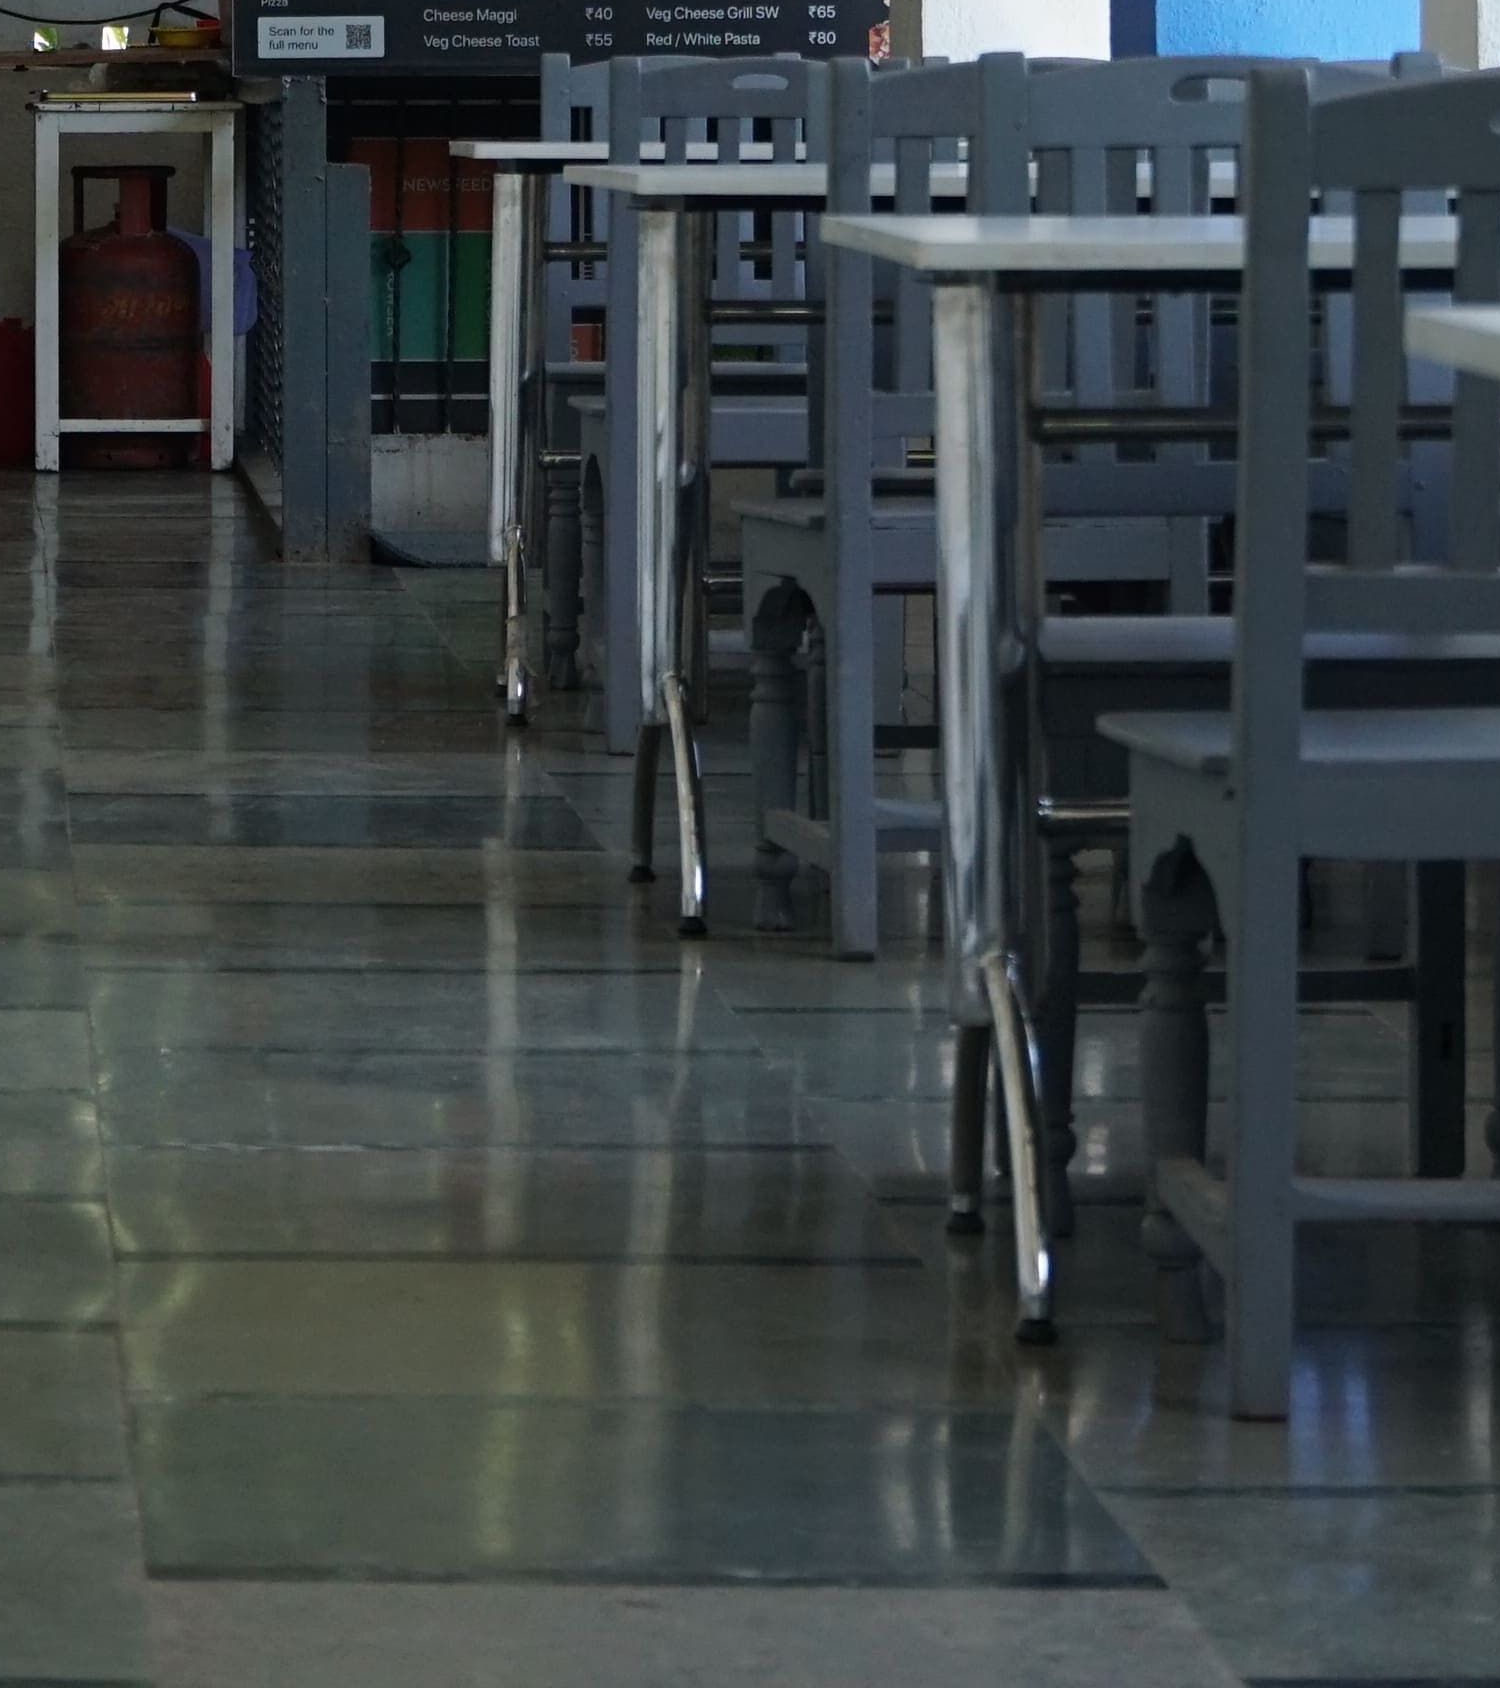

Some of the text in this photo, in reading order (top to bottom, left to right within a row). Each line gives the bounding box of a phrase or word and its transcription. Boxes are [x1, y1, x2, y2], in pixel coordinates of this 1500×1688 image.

[423, 7, 518, 25] Cheese Maggi
[585, 7, 613, 21] ₹40
[645, 5, 780, 23] Veg Cheese Grill SW
[808, 4, 836, 19] ₹65
[268, 25, 335, 37] Scan for the
[808, 31, 837, 45] ₹80
[268, 39, 319, 51] full menu
[423, 33, 540, 51] Veg Cheese Toast
[585, 33, 613, 47] ₹55
[646, 32, 761, 48] Red / White Pasta
